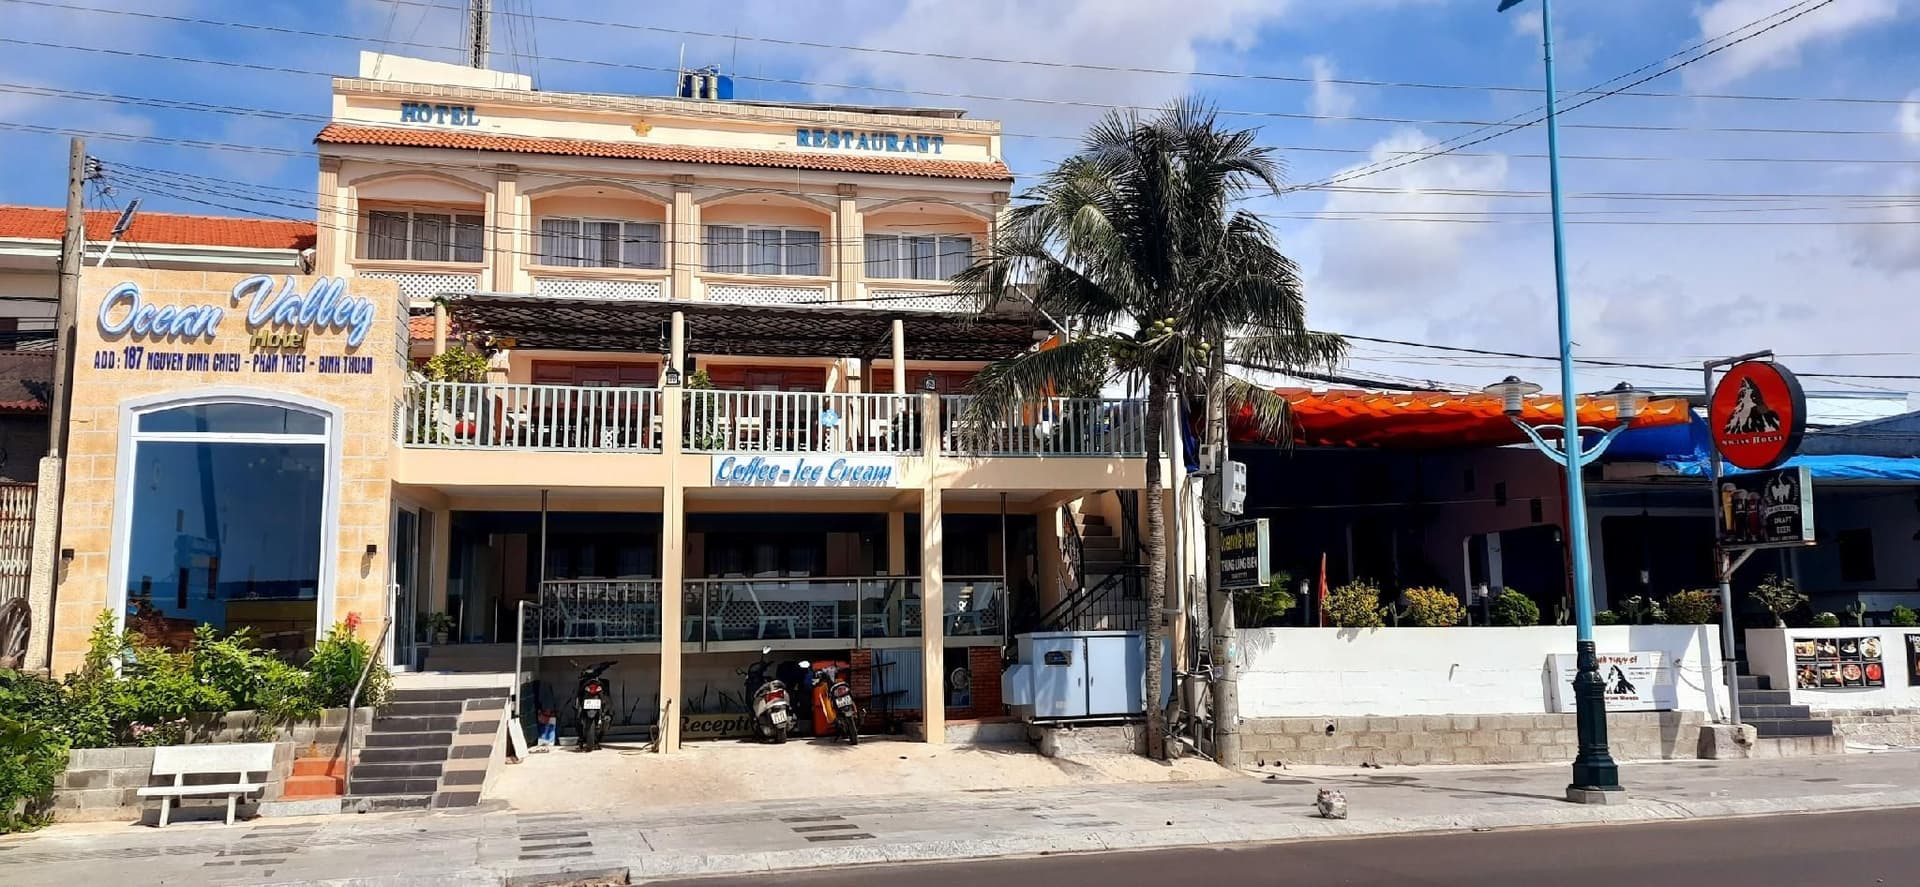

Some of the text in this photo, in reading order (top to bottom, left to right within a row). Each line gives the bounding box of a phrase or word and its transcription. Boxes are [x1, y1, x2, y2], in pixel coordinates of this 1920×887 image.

[400, 102, 944, 154] HOTEL RESTAURANT
[99, 275, 375, 346] Ocean Valley
[250, 329, 308, 348] Hotel
[123, 345, 144, 370] 187
[147, 352, 184, 371] NGUYEN
[186, 353, 210, 372] DINH
[212, 353, 241, 372] CHIEU
[252, 353, 278, 373] PHAN
[281, 354, 306, 373] THIET
[318, 355, 340, 374] BINH
[343, 355, 373, 374] THUAN
[717, 456, 780, 482] Coffee
[793, 458, 823, 481] Ice
[827, 458, 892, 481] Cream
[681, 715, 751, 735] Recepti
